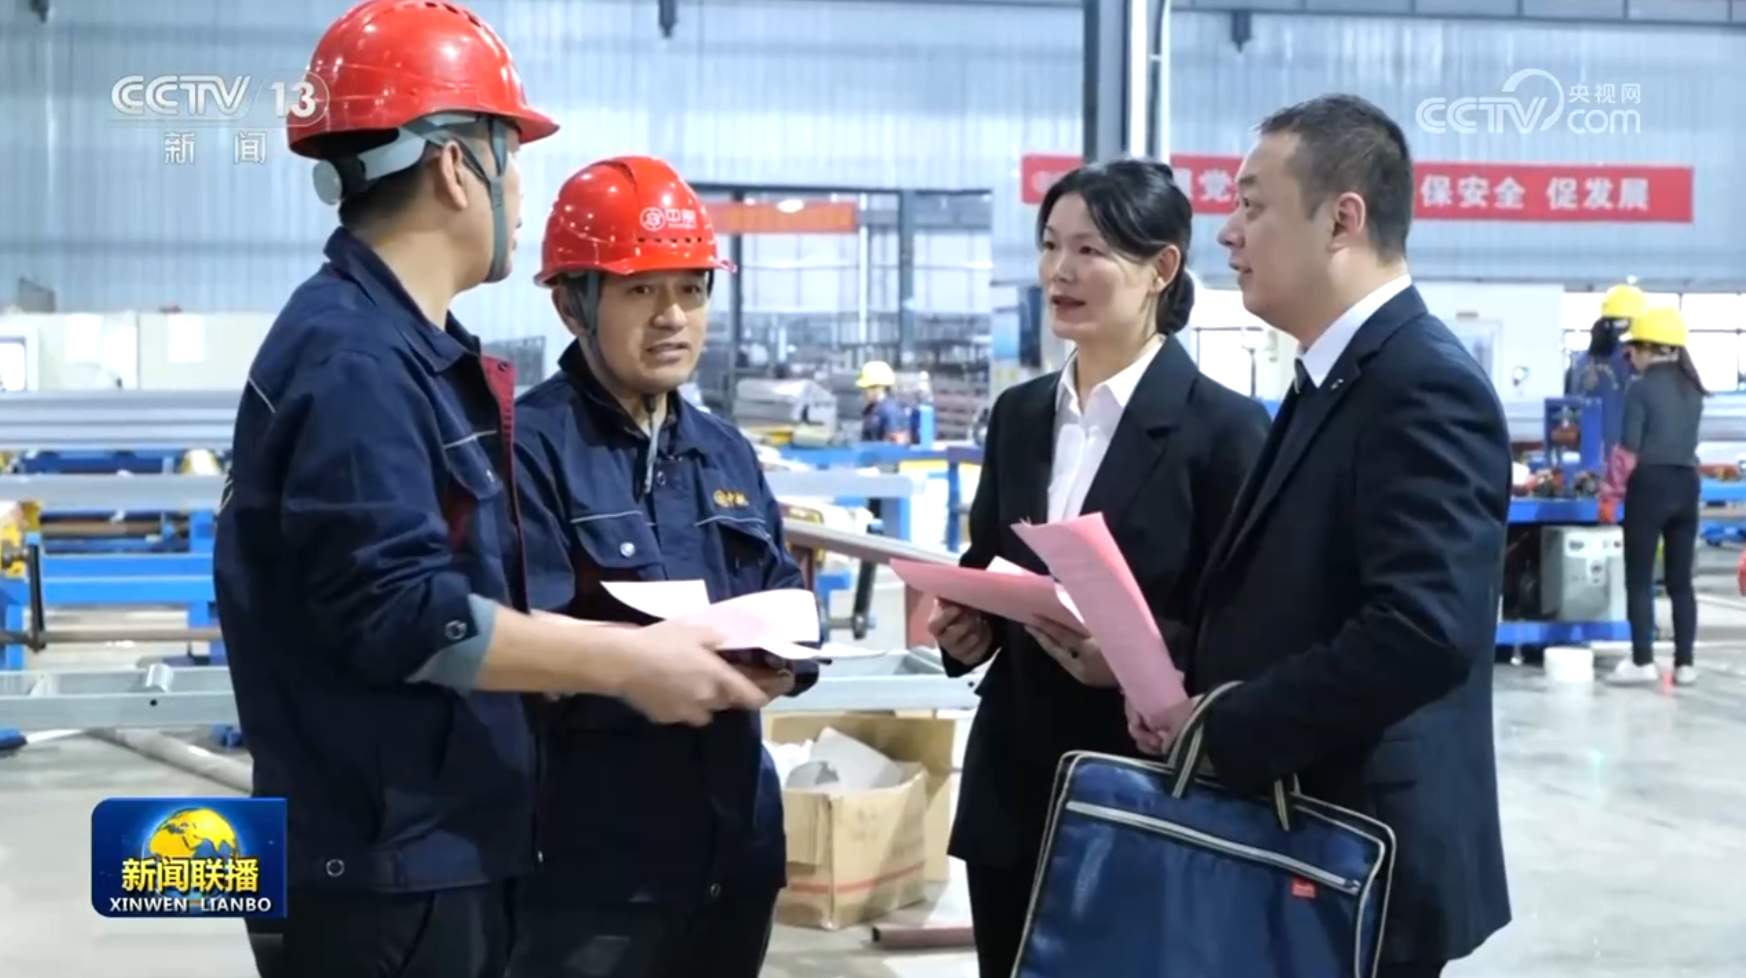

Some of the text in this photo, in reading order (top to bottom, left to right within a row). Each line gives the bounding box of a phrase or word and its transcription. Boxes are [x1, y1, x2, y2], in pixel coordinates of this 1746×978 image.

[1420, 174, 1525, 208] 保安全
[1547, 177, 1649, 211] 促发展
